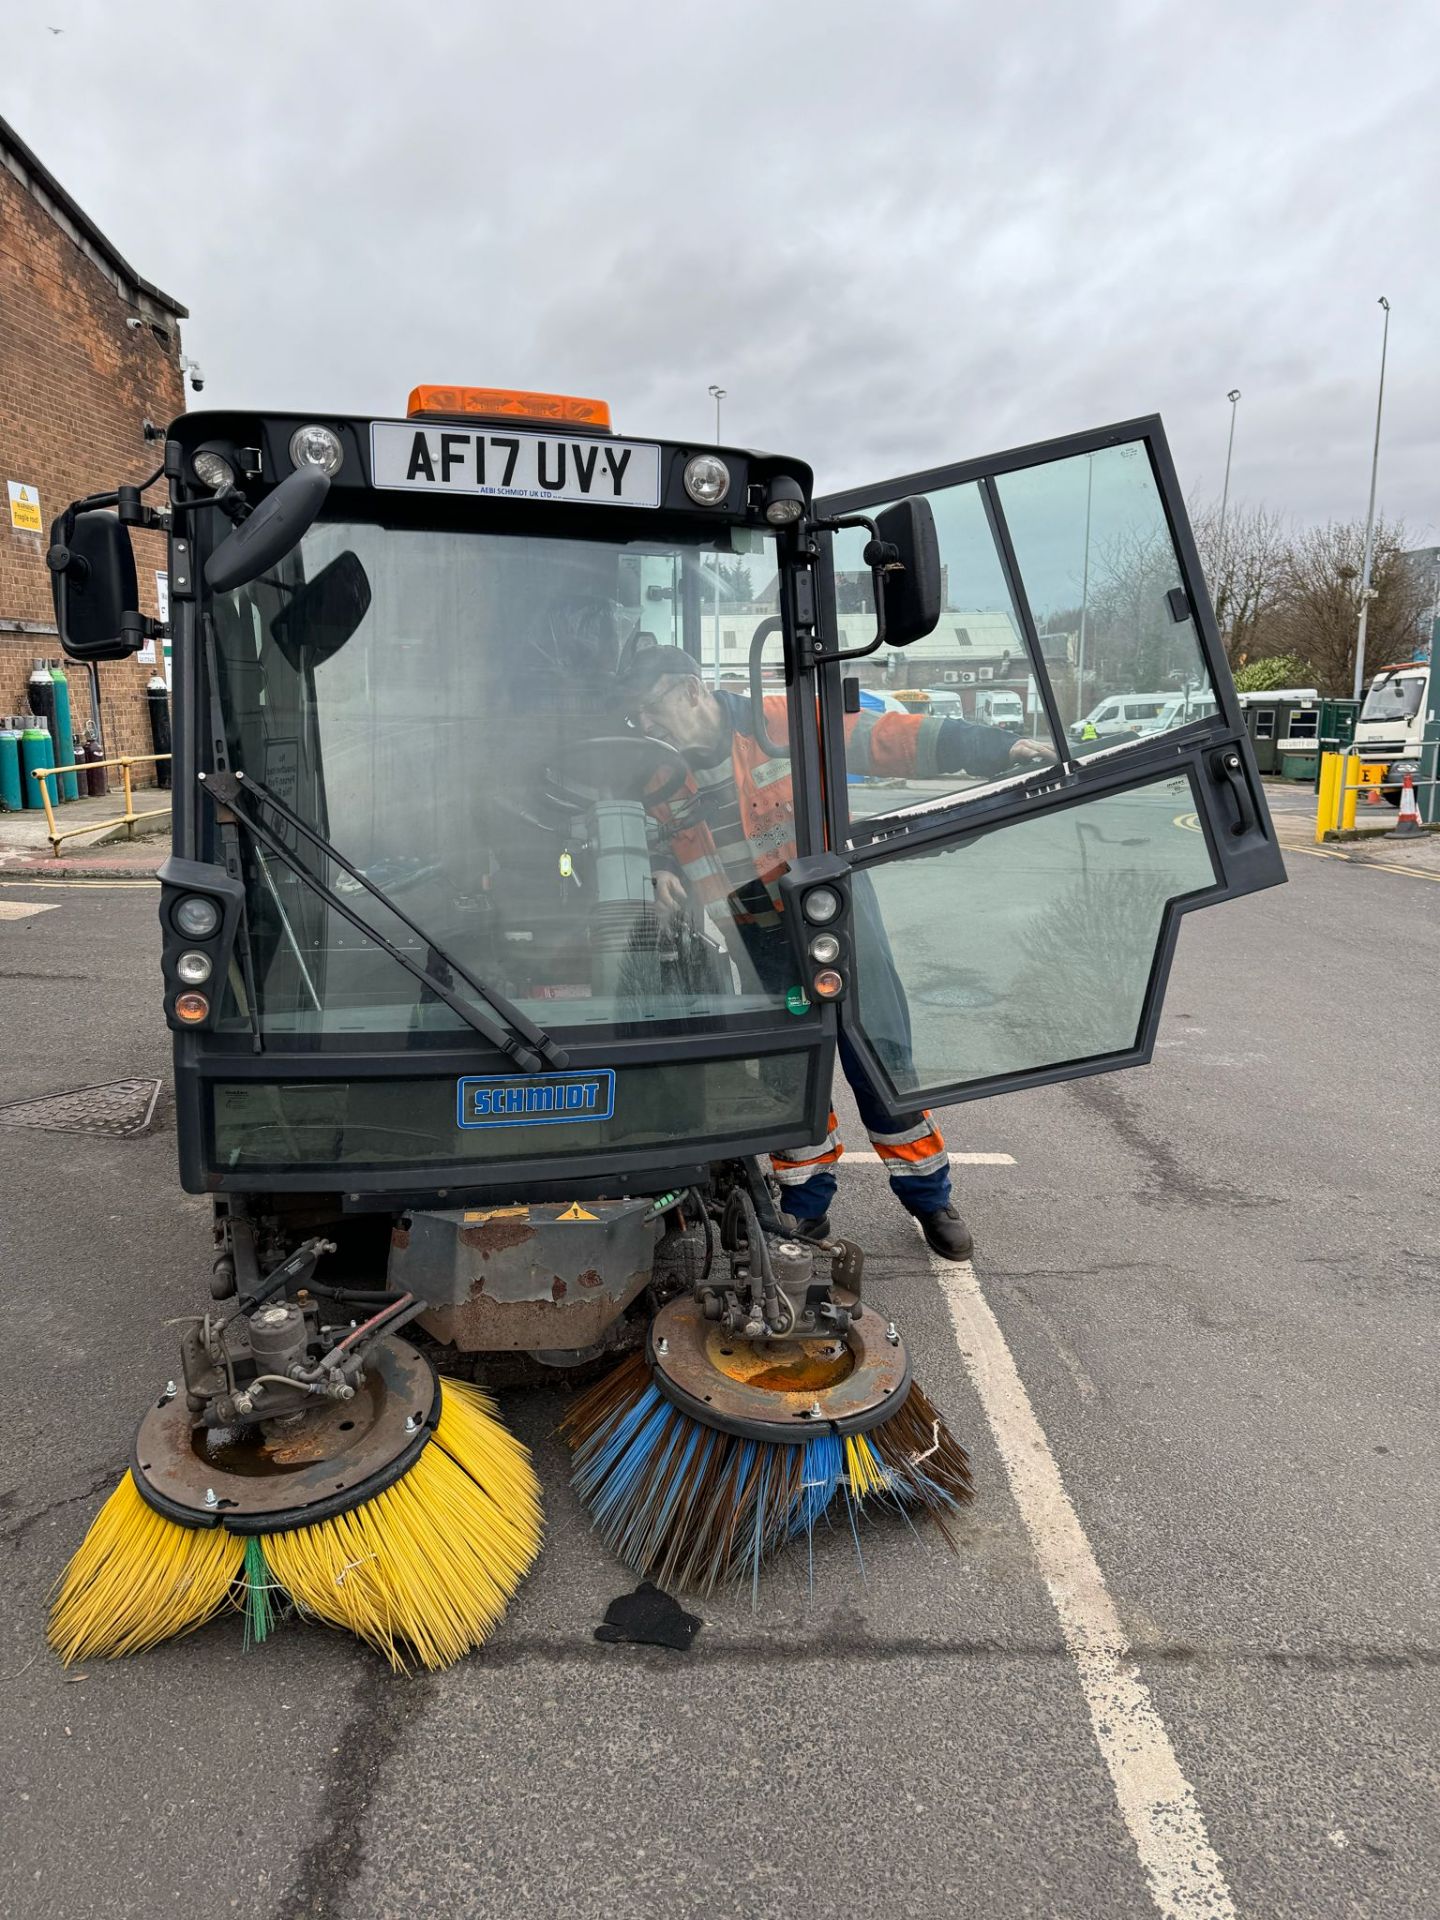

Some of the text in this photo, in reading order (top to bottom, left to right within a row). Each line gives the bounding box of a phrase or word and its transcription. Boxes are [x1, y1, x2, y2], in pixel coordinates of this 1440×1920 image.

[406, 431, 632, 496] AF17 UVY
[480, 486, 496, 494] AEBI
[497, 487, 529, 497] SCHMIDT
[530, 489, 539, 497] UK
[474, 1083, 600, 1115] SCHMIDT
